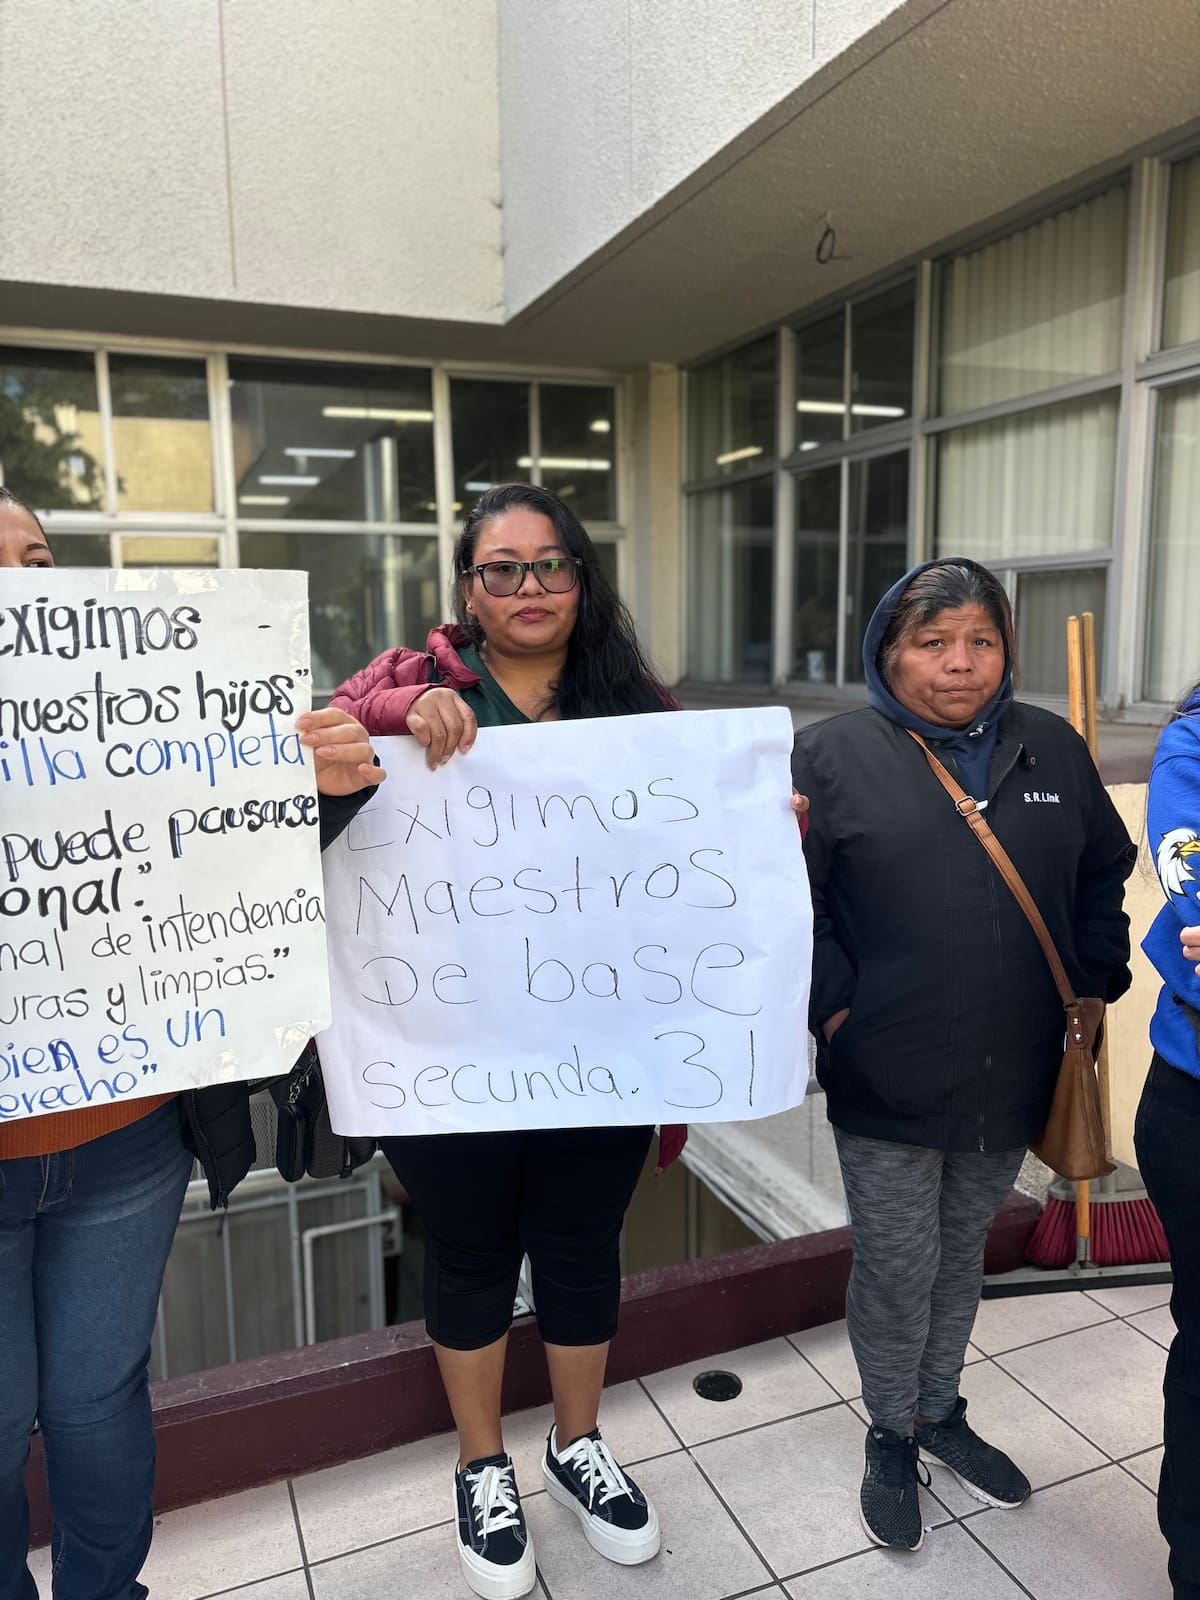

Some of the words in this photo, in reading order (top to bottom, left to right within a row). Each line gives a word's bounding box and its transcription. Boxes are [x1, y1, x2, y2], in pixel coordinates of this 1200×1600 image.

[0, 670, 181, 743] nuestros
[105, 712, 305, 787] completa
[2, 808, 150, 882] puede
[168, 794, 320, 859] pausarse
[347, 777, 699, 851] Exigimos
[91, 921, 132, 957] de
[142, 887, 326, 953] intendencia
[356, 848, 737, 935] Maestros
[106, 982, 127, 1025] y
[360, 955, 479, 1006] De
[524, 936, 763, 1017] base
[97, 1024, 149, 1064] es
[654, 1030, 754, 1109] 31
